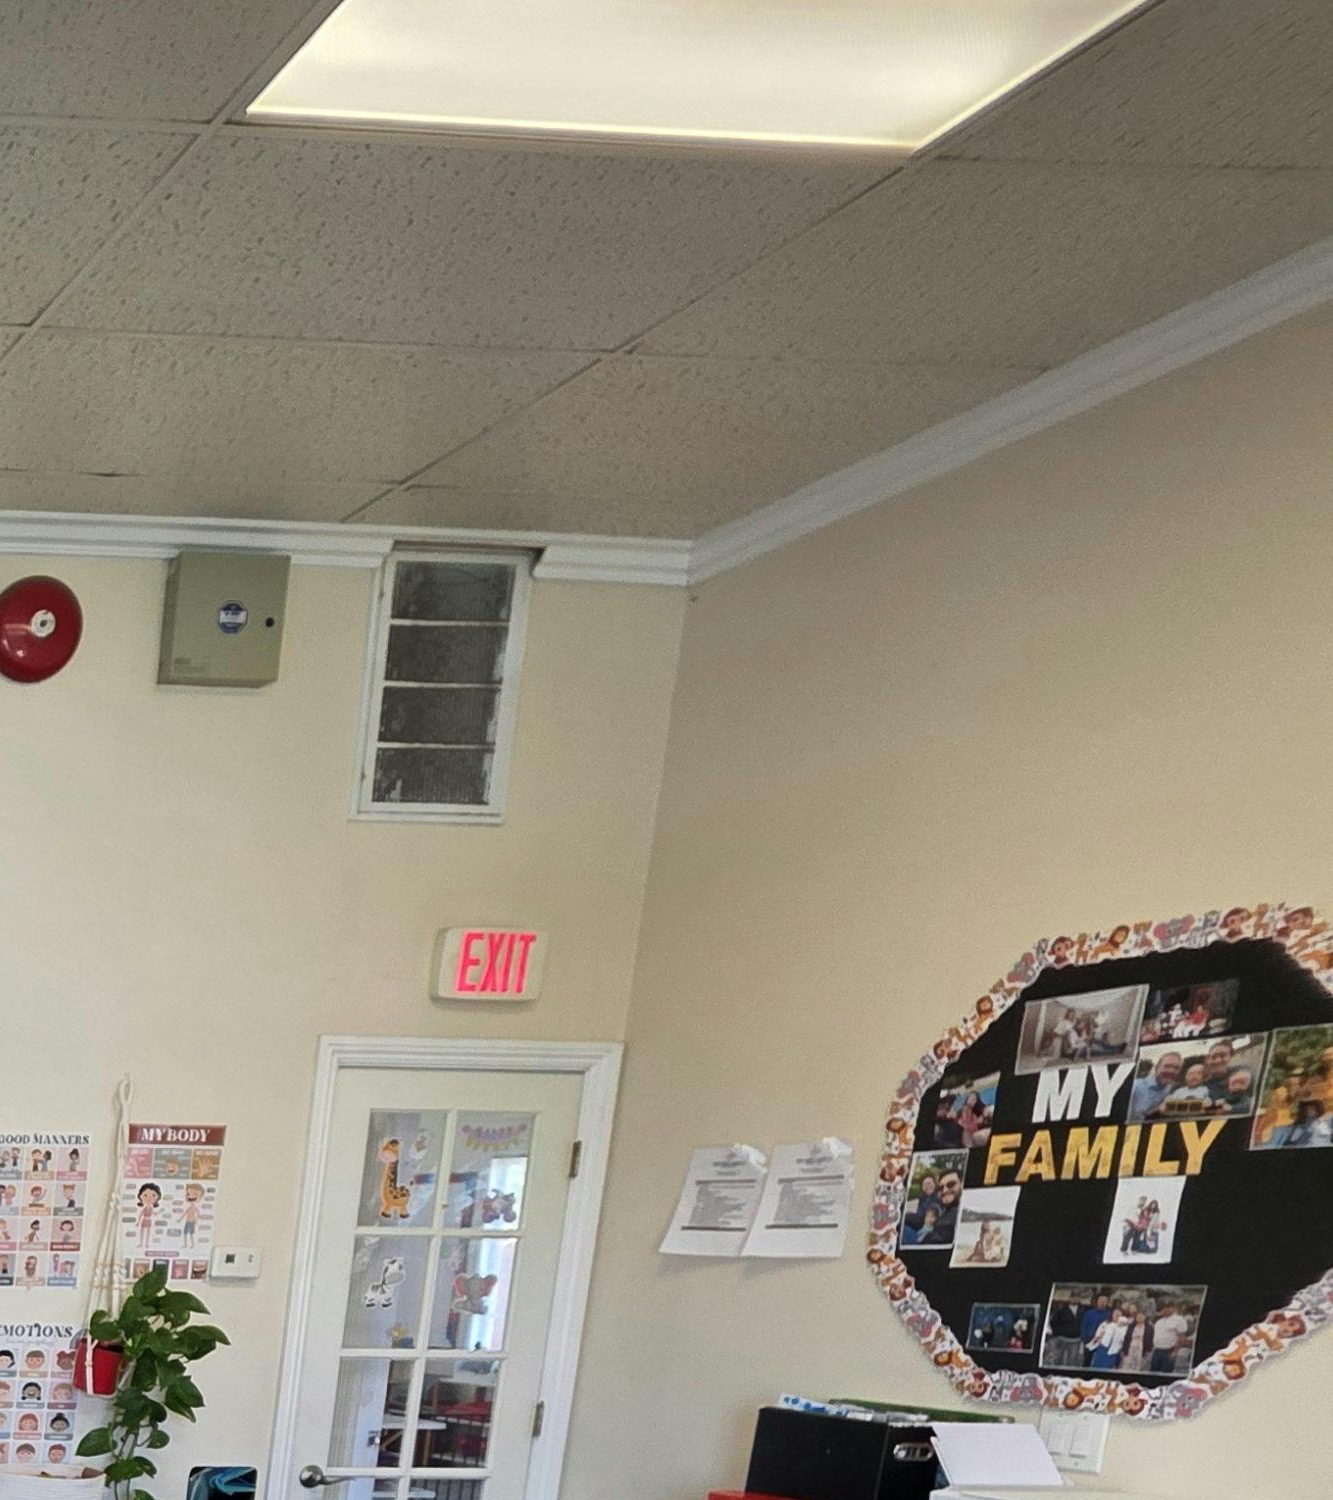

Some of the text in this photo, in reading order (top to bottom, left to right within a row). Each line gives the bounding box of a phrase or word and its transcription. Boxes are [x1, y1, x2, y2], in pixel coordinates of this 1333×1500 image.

[456, 931, 537, 994] EXIT
[1031, 1062, 1135, 1124] MY
[33, 1133, 90, 1145] MANNERS
[141, 1128, 210, 1142] MY BODY
[983, 1119, 1229, 1185] FAMILY
